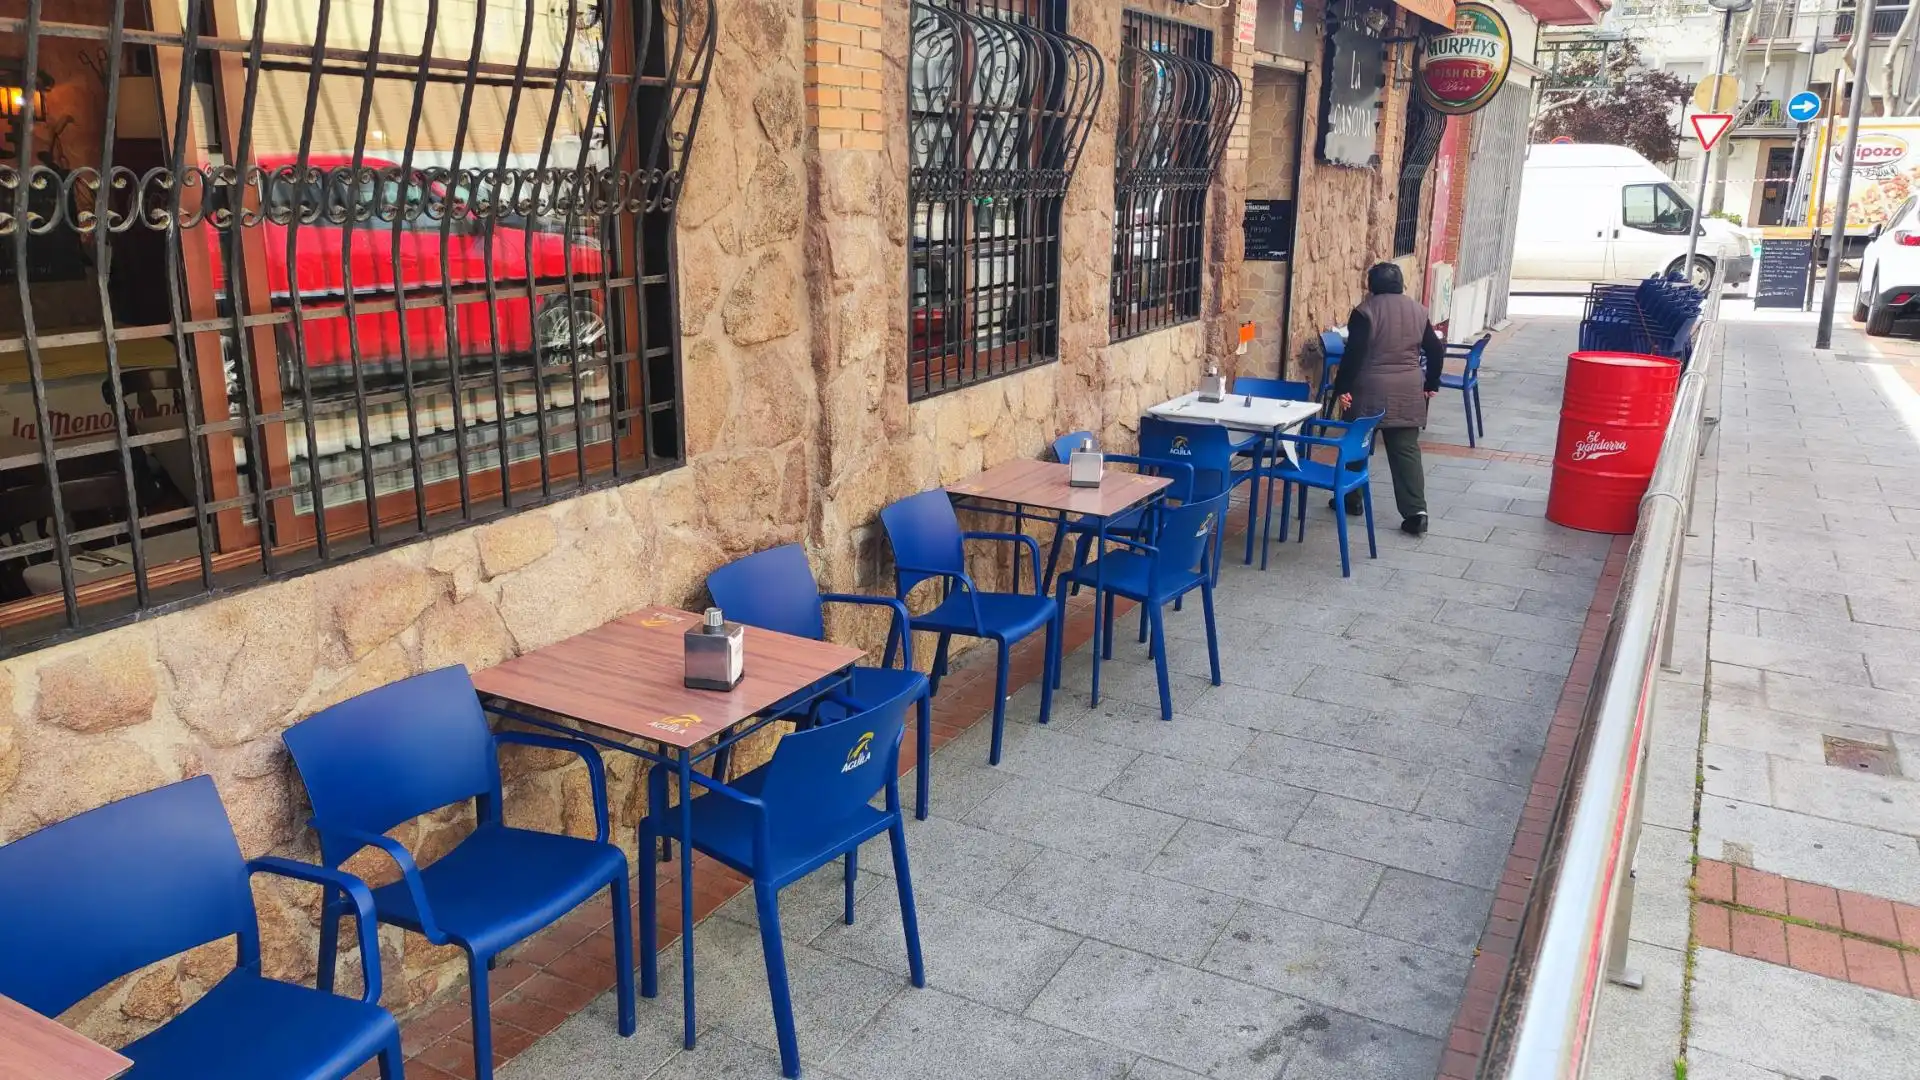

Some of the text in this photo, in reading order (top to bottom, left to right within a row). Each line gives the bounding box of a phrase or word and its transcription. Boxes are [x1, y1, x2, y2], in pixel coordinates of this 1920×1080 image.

[1463, 68, 1486, 78] RED
[1587, 430, 1601, 443] El
[1572, 439, 1628, 461] Bandarra
[841, 752, 871, 773] AGUILA
